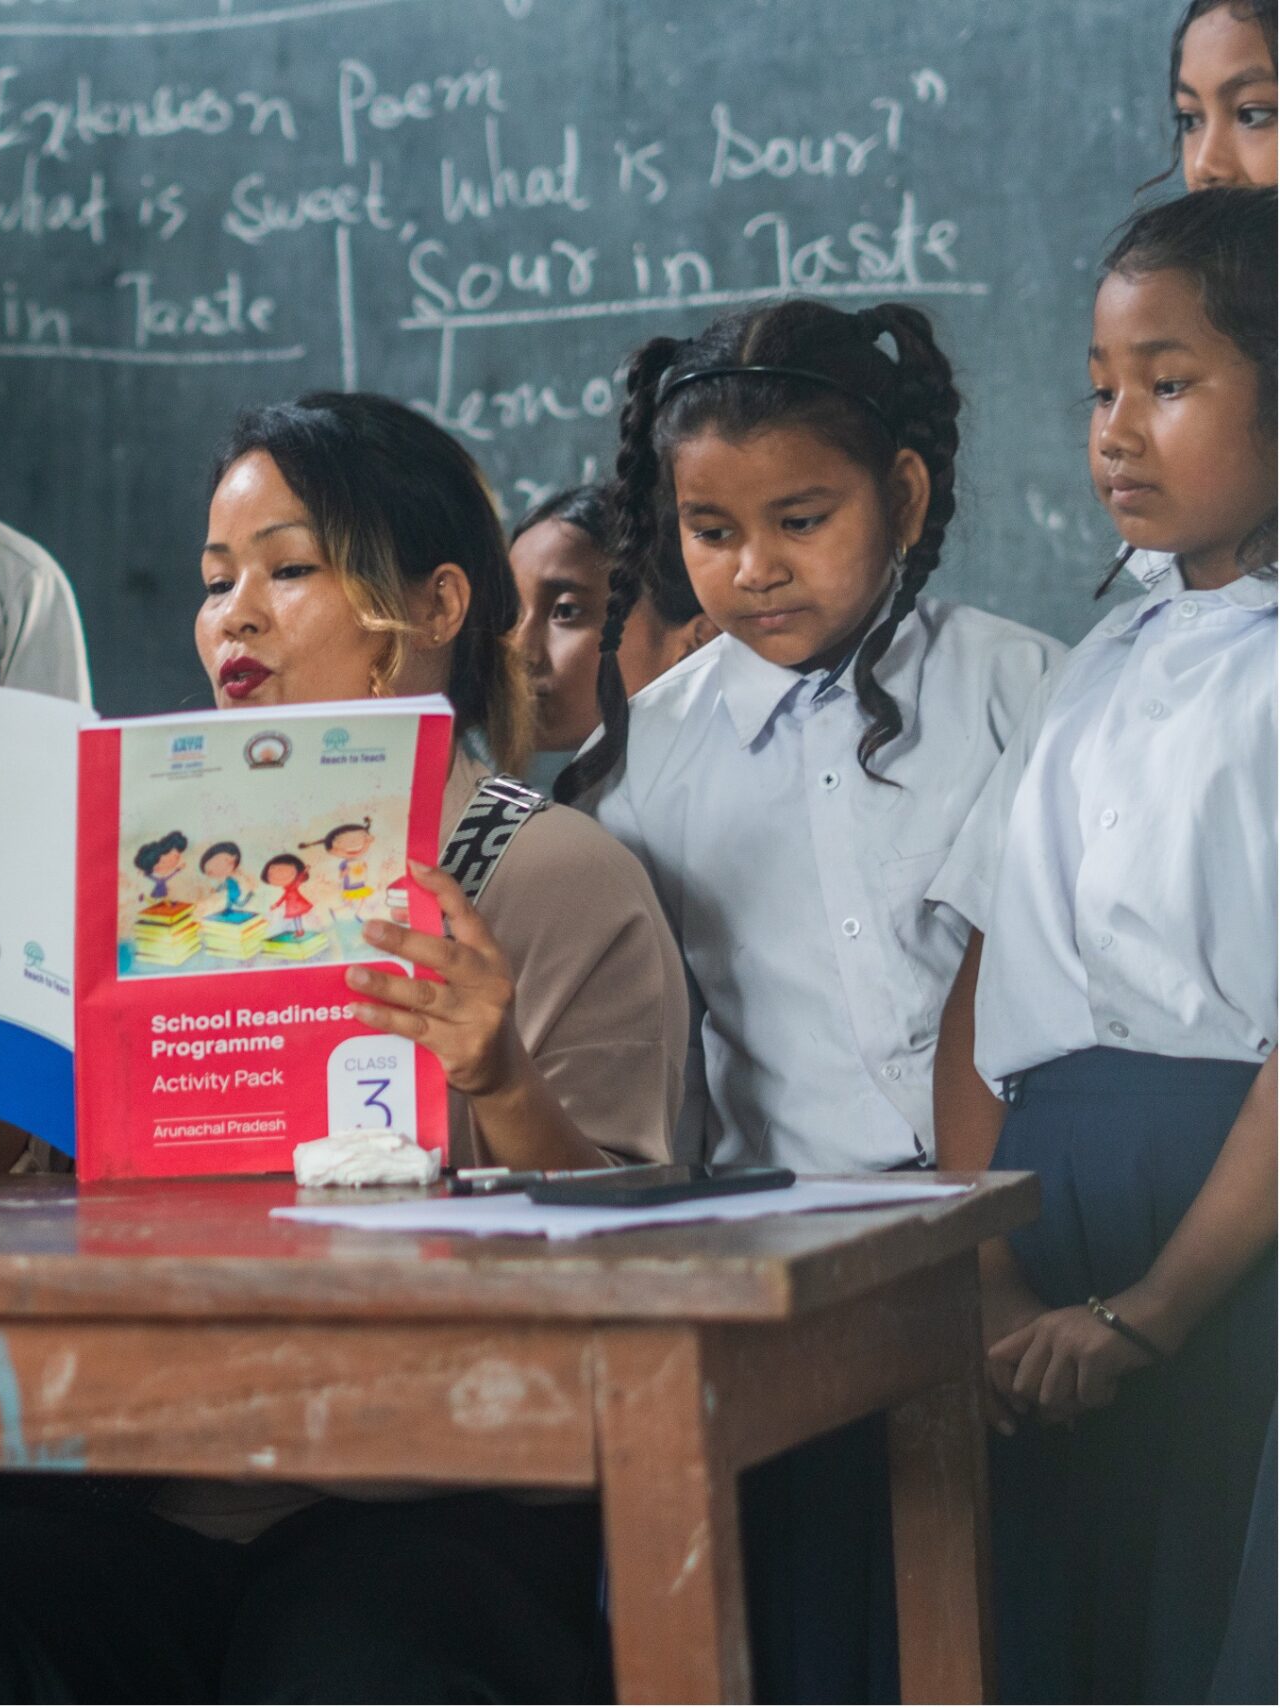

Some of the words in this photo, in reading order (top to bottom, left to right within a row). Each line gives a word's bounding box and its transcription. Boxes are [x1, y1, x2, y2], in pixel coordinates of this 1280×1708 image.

[341, 59, 506, 166] Poem
[137, 173, 189, 241] is
[613, 136, 670, 204] is
[407, 238, 599, 322] Sour
[631, 241, 714, 300] in
[741, 188, 961, 290] Taste
[3, 278, 72, 347] in
[115, 271, 278, 350] Taste
[408, 325, 630, 441] Lemo
[320, 755, 347, 766] Reach
[349, 754, 359, 764] to
[361, 752, 386, 764] Teach
[23, 967, 45, 984] Reach
[53, 979, 71, 996] Teach
[150, 1009, 232, 1034] School
[235, 1002, 355, 1028] Readiness
[150, 1033, 286, 1061] Programme
[343, 1055, 398, 1072] CLASS
[152, 1070, 231, 1094] Activity
[234, 1067, 285, 1089] Pack
[356, 1078, 393, 1129] 3
[152, 1122, 226, 1140] Arunachal
[226, 1117, 287, 1134] Pradesh
